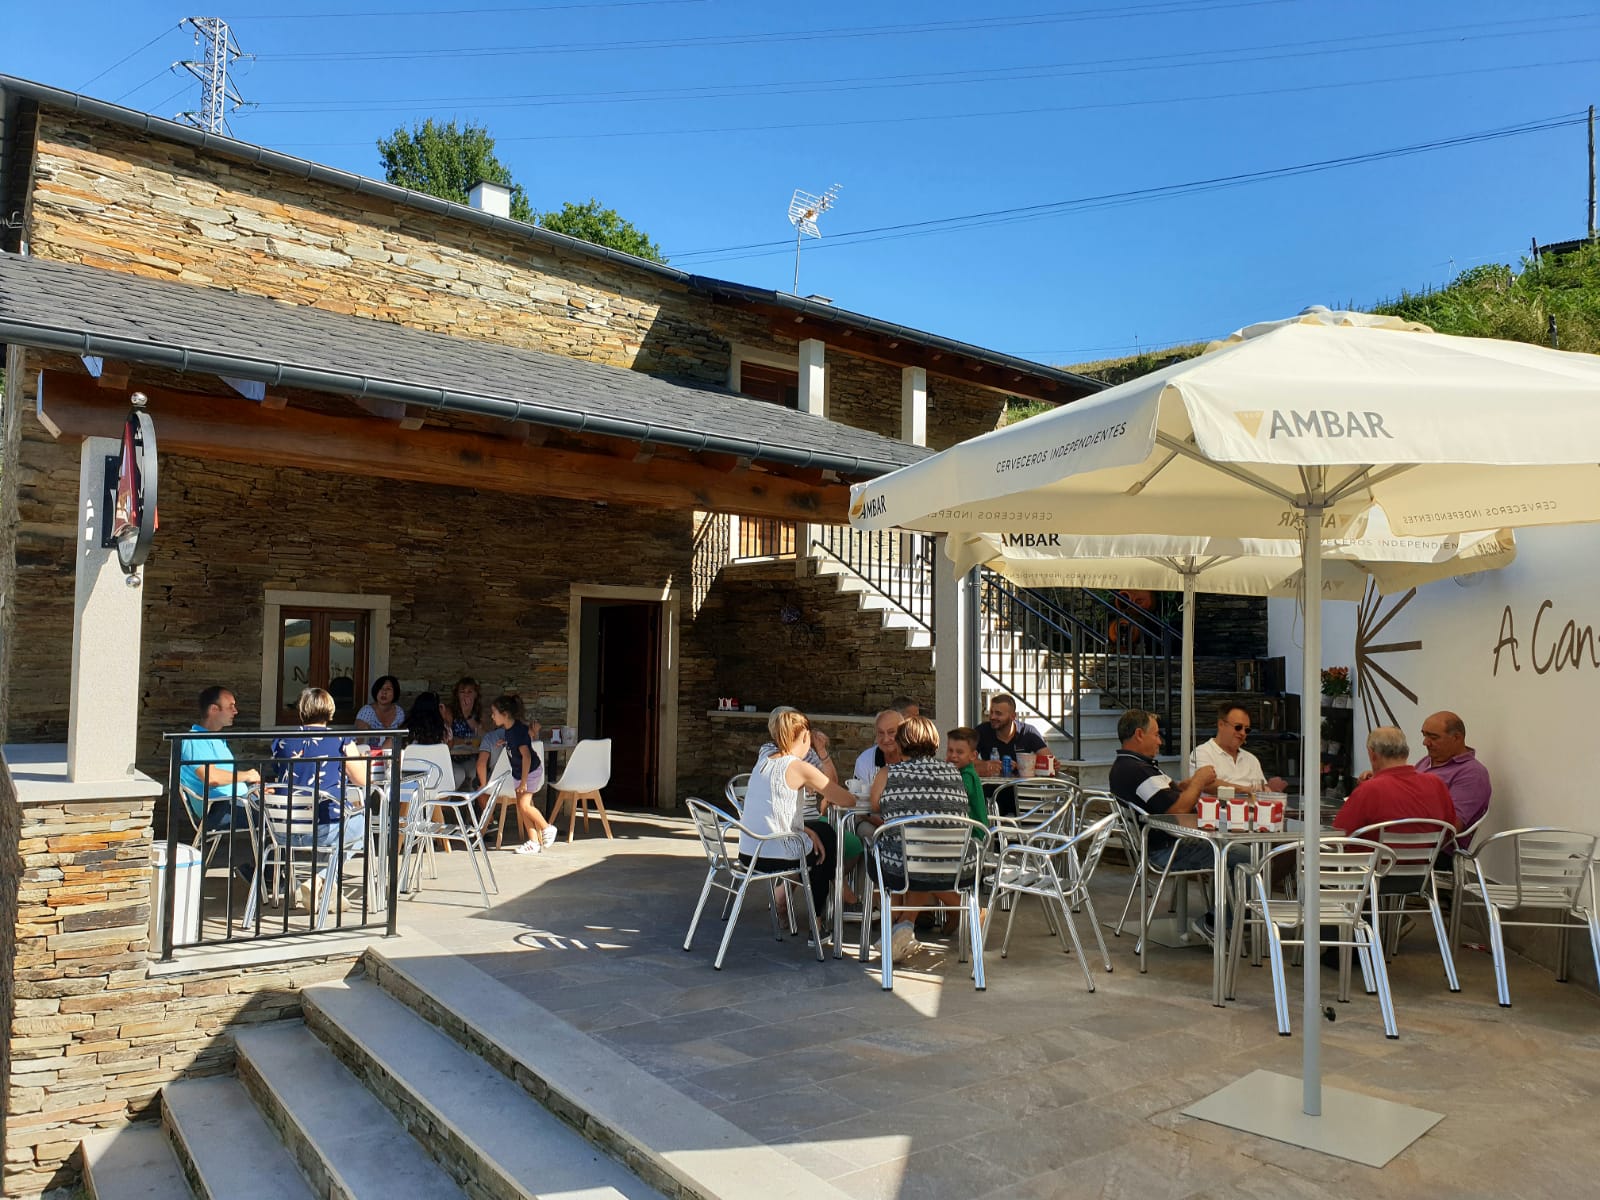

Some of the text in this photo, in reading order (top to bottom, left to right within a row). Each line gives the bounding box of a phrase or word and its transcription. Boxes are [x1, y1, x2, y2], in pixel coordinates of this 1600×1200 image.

[1269, 409, 1395, 440] AMBAR
[995, 421, 1127, 474] CERVECEROS INDEPENDIENTES
[857, 494, 887, 519] AMBAR
[1001, 532, 1061, 547] AMBAR
[1493, 599, 1600, 677] A Can
